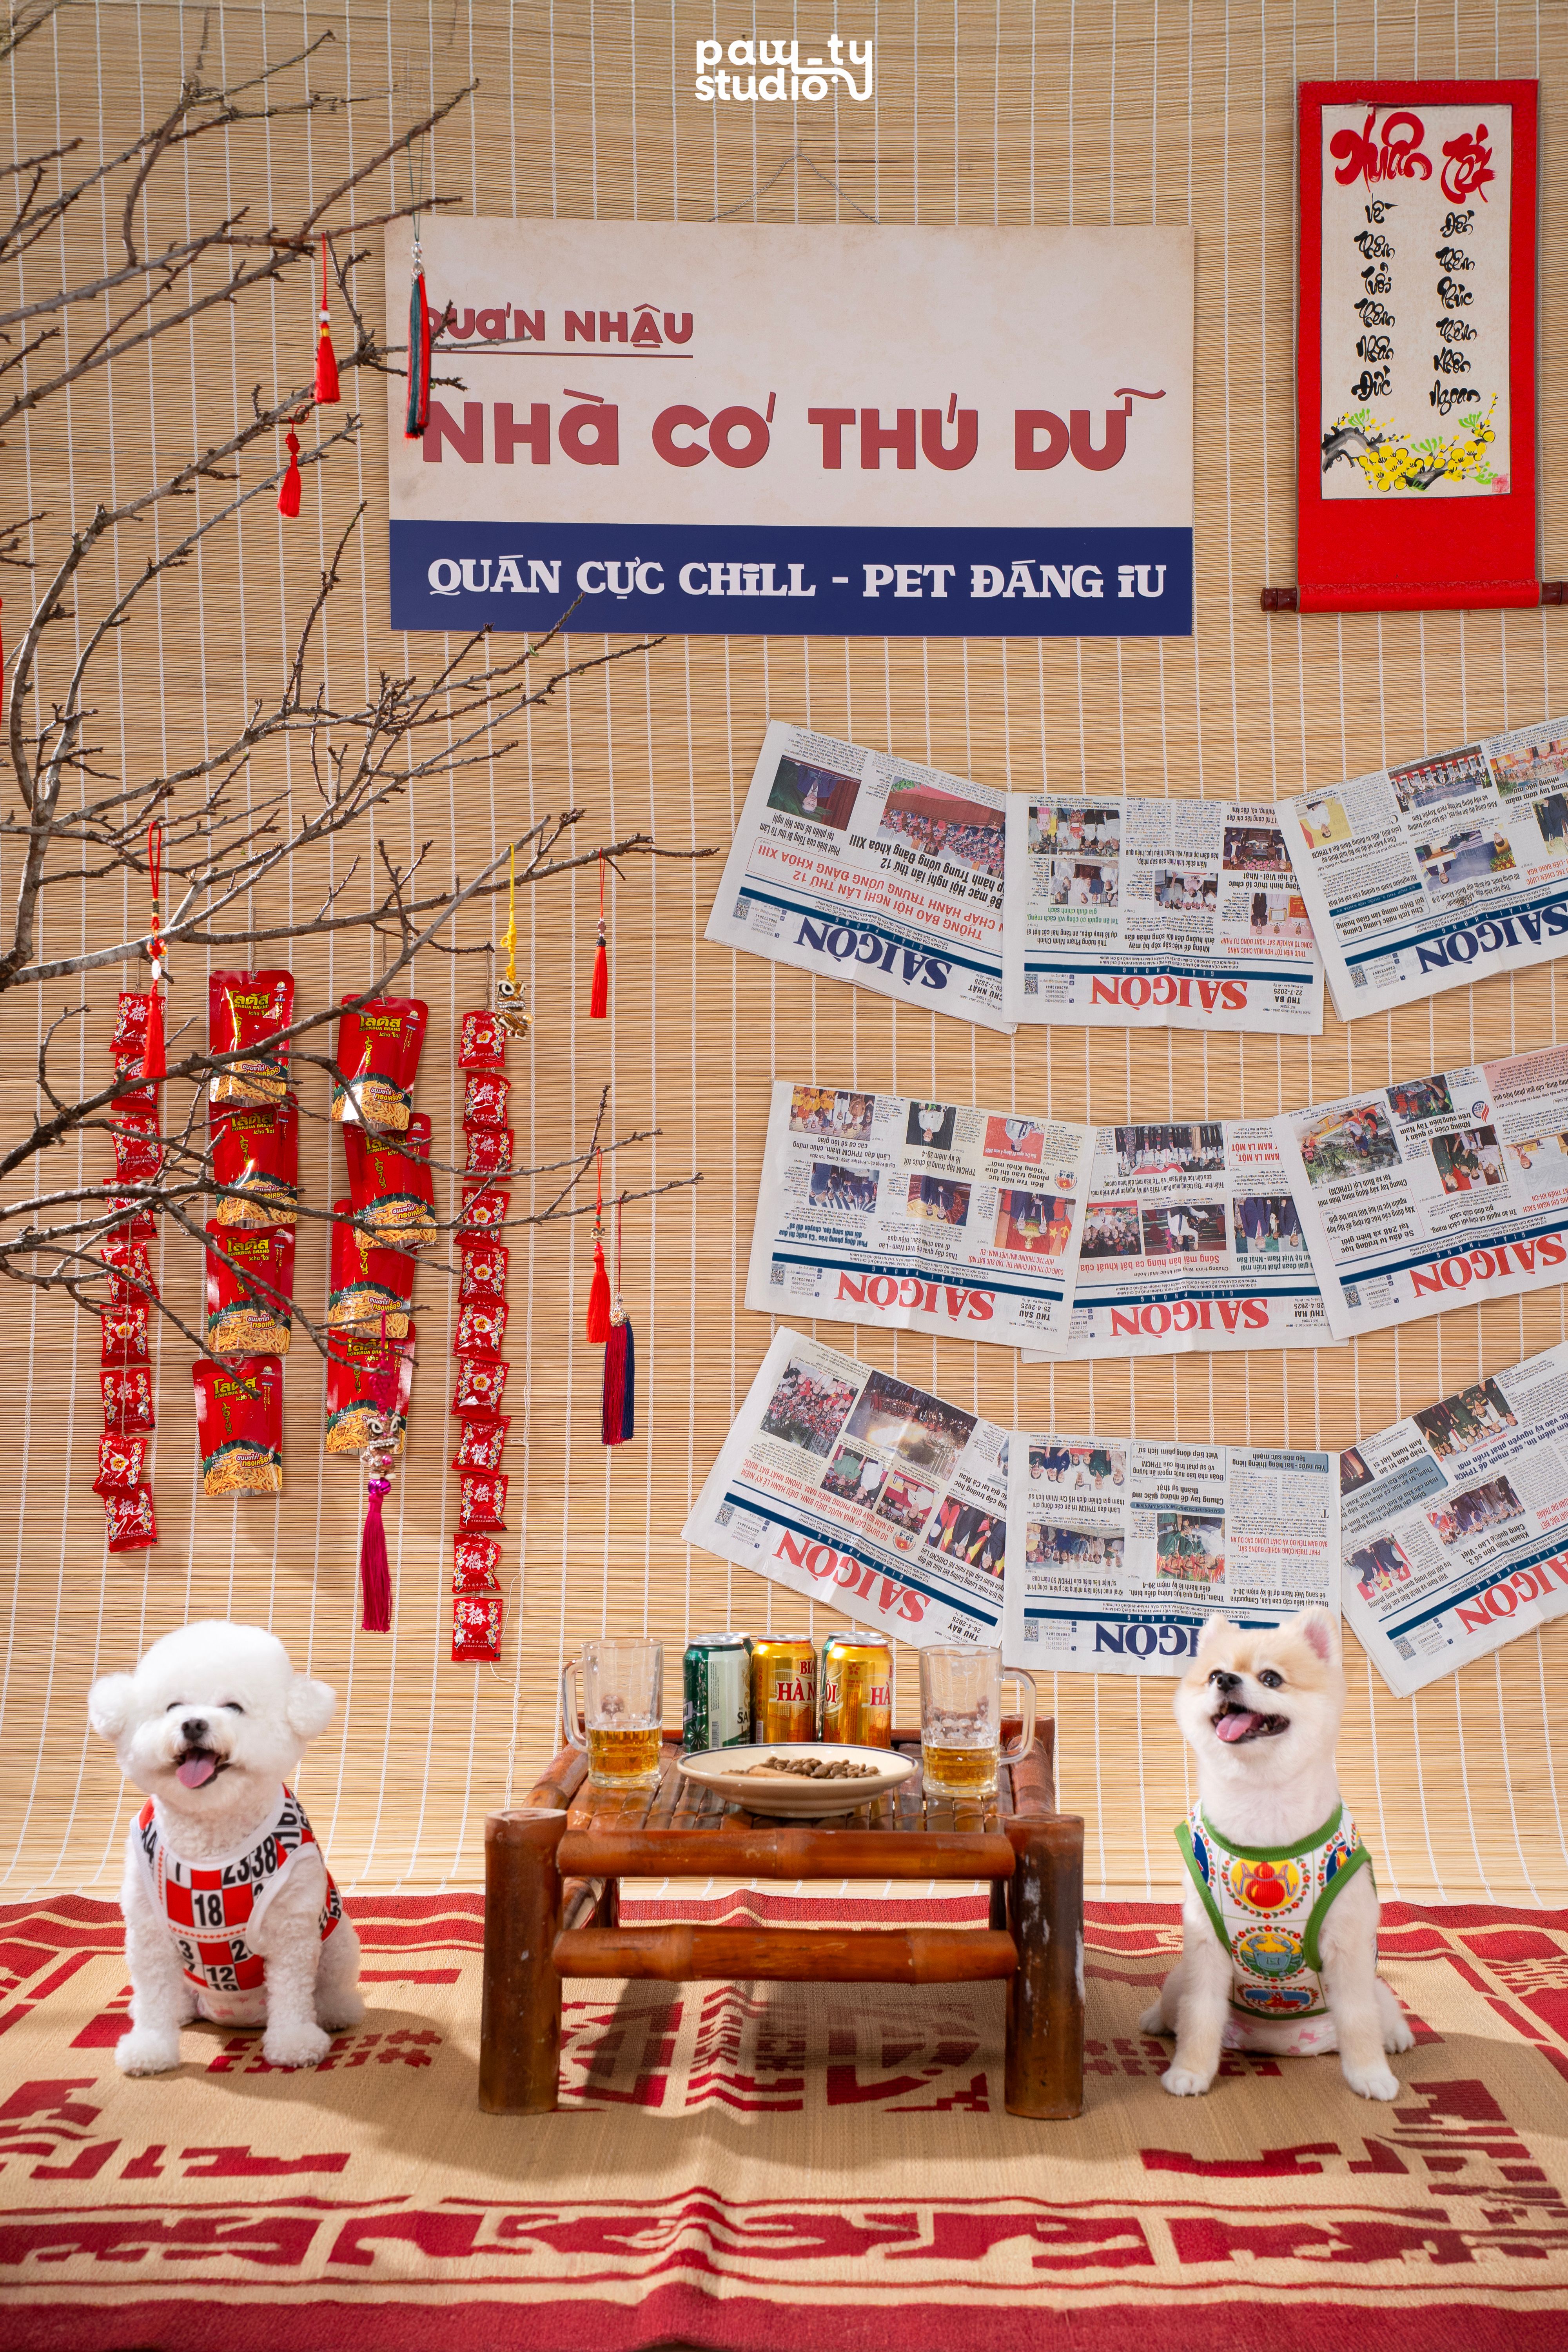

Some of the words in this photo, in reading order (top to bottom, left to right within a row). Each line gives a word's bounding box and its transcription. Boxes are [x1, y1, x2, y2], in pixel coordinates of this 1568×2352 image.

[565, 304, 692, 347] NHẬU
[808, 393, 977, 470] THÚ
[1015, 388, 1165, 470] DỮ
[428, 555, 561, 595] QUÁN
[577, 557, 664, 599] CỰC
[863, 564, 955, 597] PET
[971, 560, 1103, 597] ĐÁNG
[758, 845, 778, 859] XIII
[782, 852, 813, 869] KHÓA
[793, 870, 806, 882] 12
[816, 863, 849, 881] ĐẢNG
[809, 876, 833, 891] THỨ
[852, 874, 884, 889] ƯƠNG
[838, 884, 861, 899] LẦN
[864, 891, 891, 907] NGHỊ
[887, 883, 924, 903] TRUNG
[893, 900, 913, 915] HỘI
[928, 899, 961, 918] HÀNH
[916, 910, 940, 925] BÁO
[964, 913, 995, 929] CHẤP
[943, 918, 981, 940] THÔNG
[1193, 943, 1209, 952] Không
[480, 1136, 497, 1152] 梅
[1355, 1240, 1378, 1249] trường
[1120, 1262, 1132, 1271] bất
[1147, 1259, 1166, 1267] hùng
[1169, 1257, 1181, 1266] bản
[1200, 1254, 1219, 1264] Sống
[1081, 1265, 1094, 1273] của
[1096, 1263, 1118, 1272] khuất
[1021, 1303, 1050, 1312] 25-4-2025
[474, 1484, 492, 1503] 梅
[947, 1623, 962, 1633] BẢY
[952, 1616, 981, 1633] 26-4-2025
[962, 1630, 977, 1641] THỨ
[1094, 1624, 1197, 1659] IGÒN
[777, 1677, 806, 1701] HÀ
[825, 1679, 837, 1707] ỘI
[870, 1681, 891, 1706] HÀ
[251, 1838, 276, 1878] 38
[194, 1894, 223, 1927] 18
[232, 1939, 252, 1962] 2
[206, 1967, 235, 1982] 12
